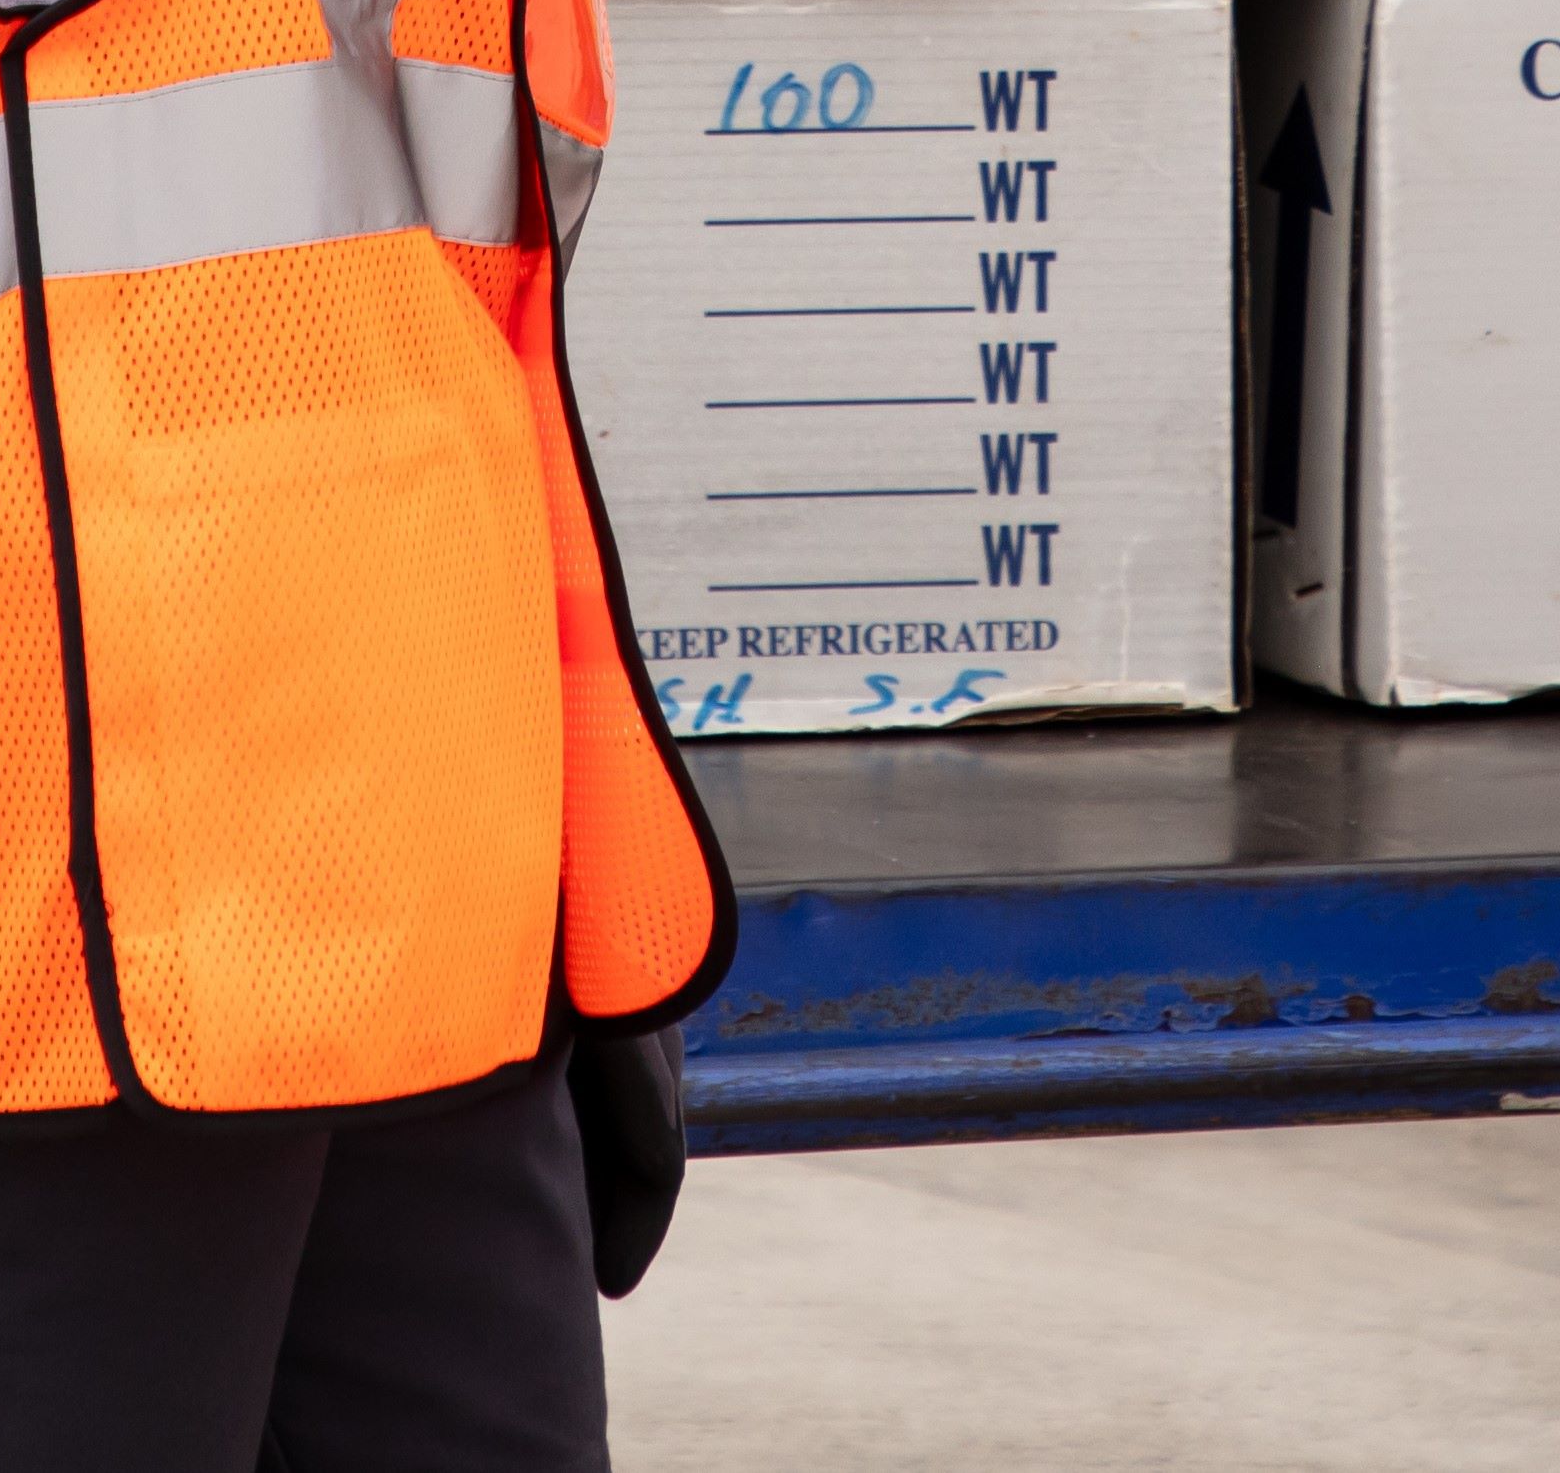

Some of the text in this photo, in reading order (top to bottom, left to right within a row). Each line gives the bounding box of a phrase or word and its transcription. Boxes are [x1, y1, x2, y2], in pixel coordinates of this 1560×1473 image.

[719, 63, 876, 135] 100
[979, 69, 1057, 132] WT
[979, 160, 1057, 223] WT
[978, 250, 1057, 314] WT
[979, 341, 1057, 404] WT
[980, 432, 1058, 496] WT
[981, 523, 1060, 587] WT
[737, 619, 1059, 658] REFRIGERATED
